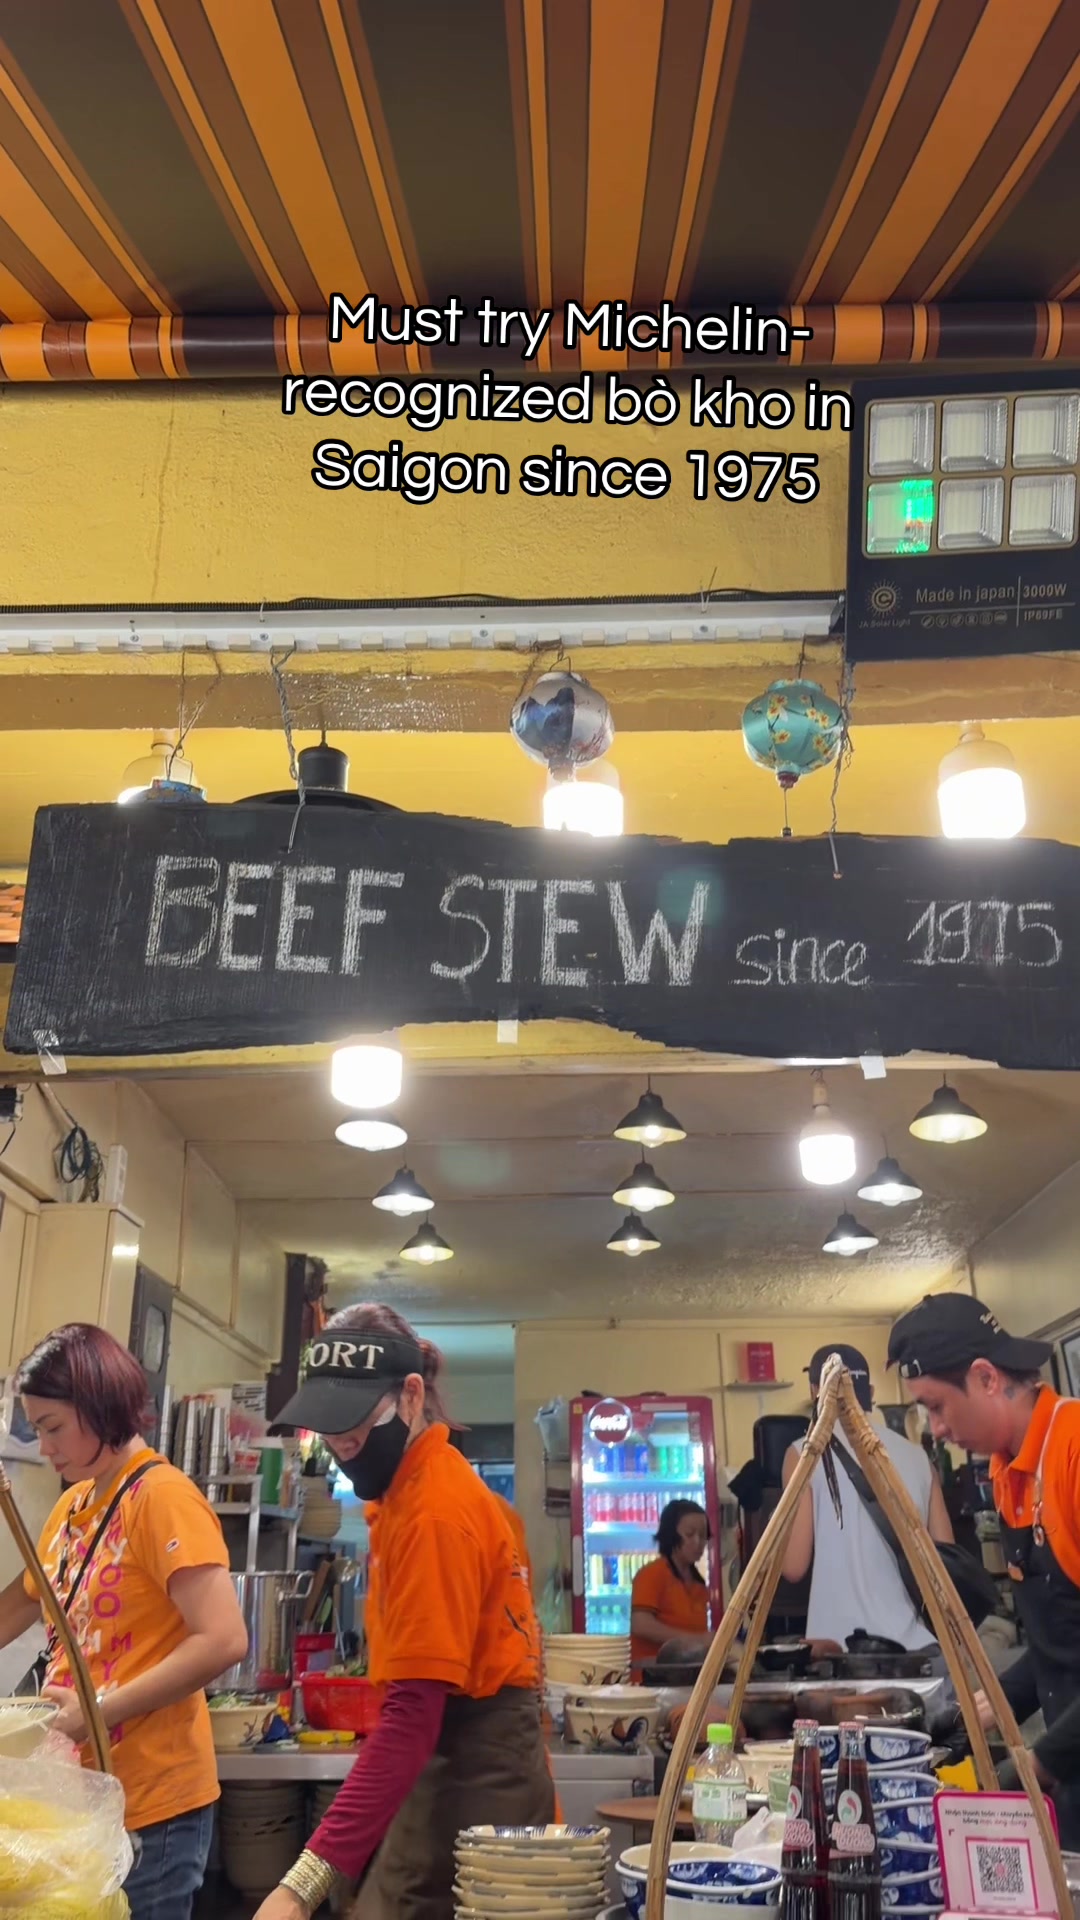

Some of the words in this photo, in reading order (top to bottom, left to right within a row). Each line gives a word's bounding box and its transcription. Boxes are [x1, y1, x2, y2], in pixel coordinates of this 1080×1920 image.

[916, 588, 954, 603] Made
[976, 585, 1015, 604] japan
[1023, 583, 1068, 598] 3000W
[145, 855, 405, 976] BEEF
[430, 874, 711, 986] STEW
[904, 899, 1062, 966] 1975
[309, 1341, 385, 1370] ORT
